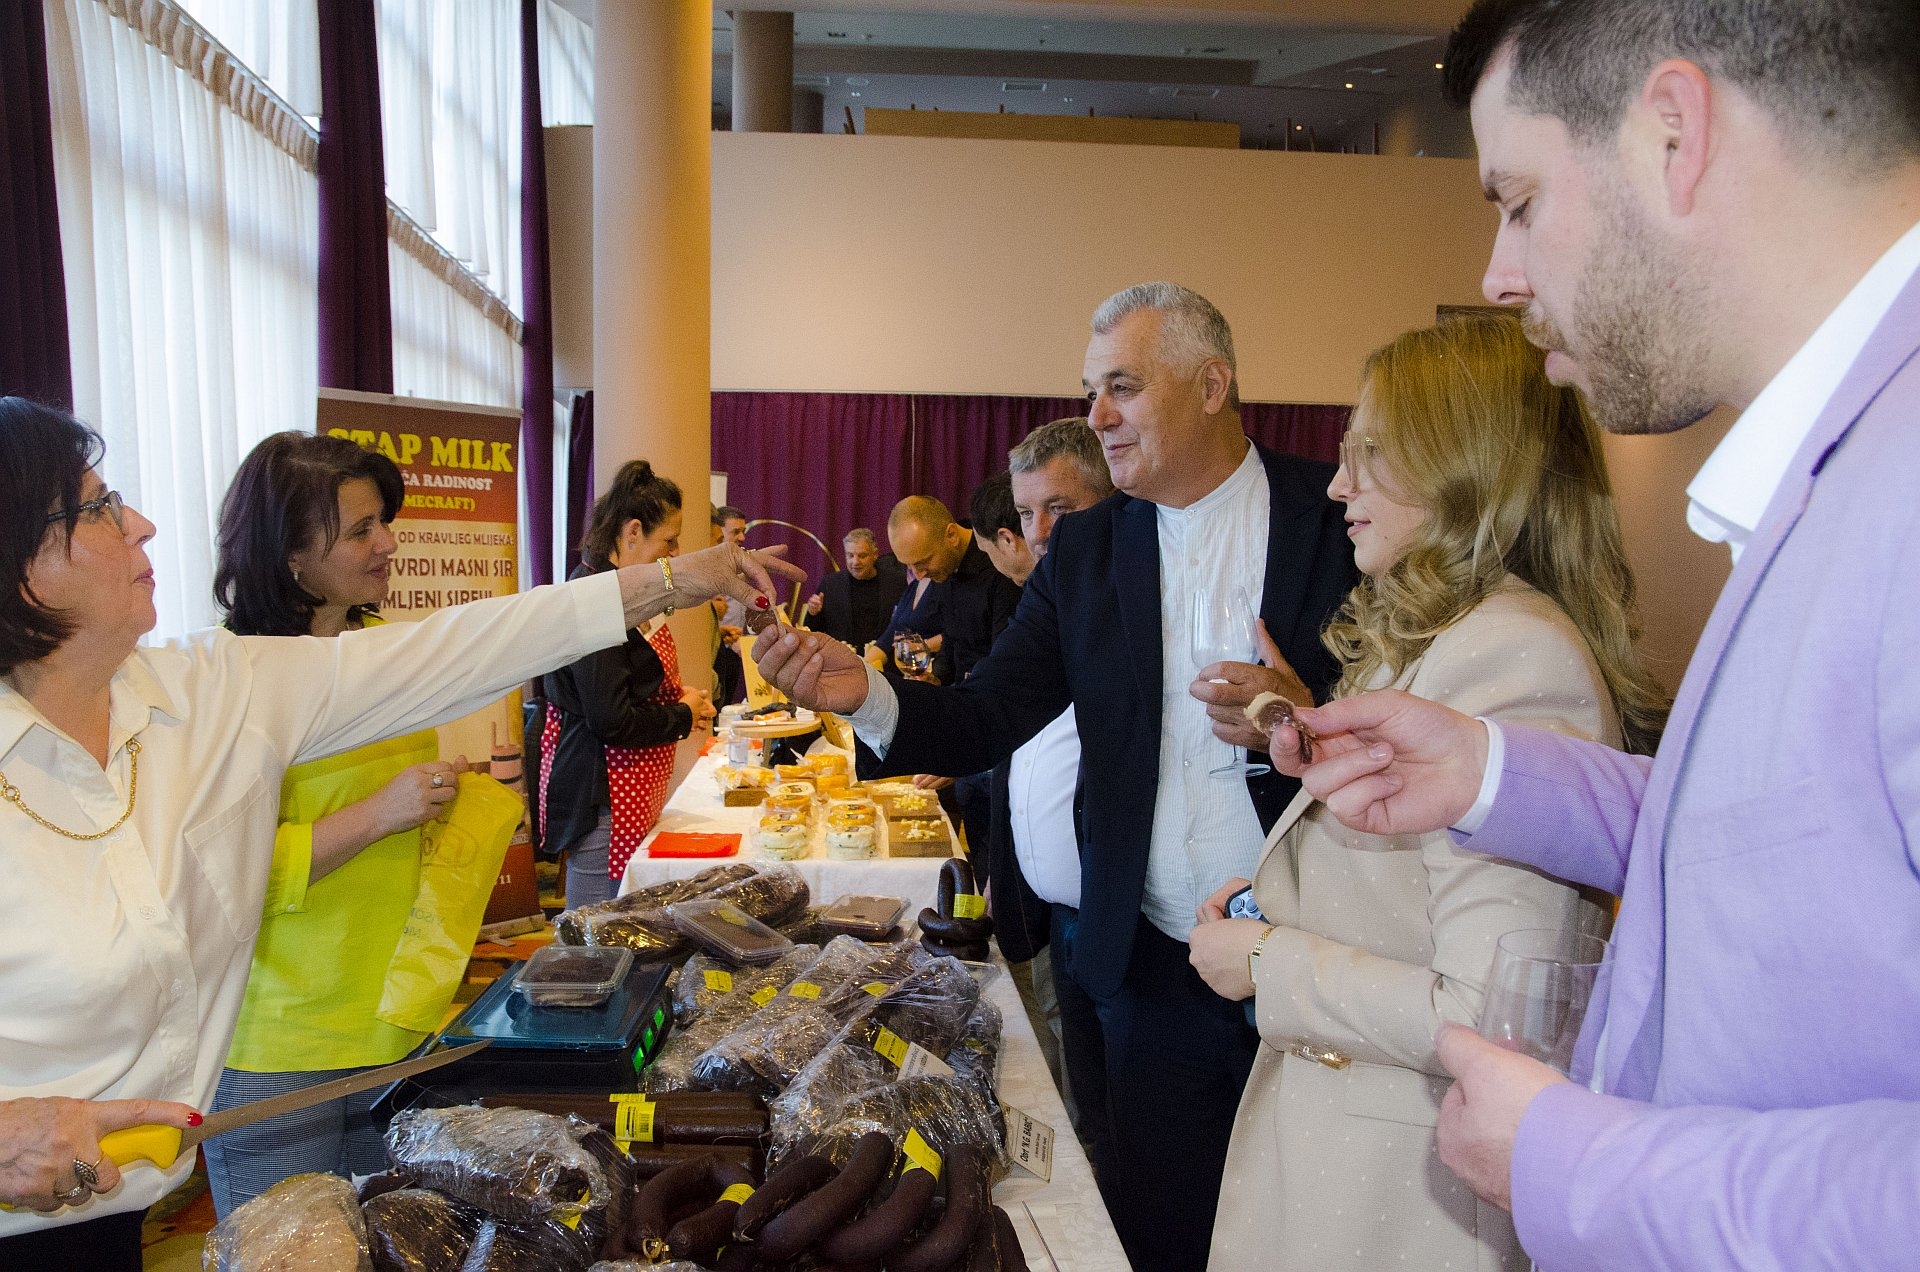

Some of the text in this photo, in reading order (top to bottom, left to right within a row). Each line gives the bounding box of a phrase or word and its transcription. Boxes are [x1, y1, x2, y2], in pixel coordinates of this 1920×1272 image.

[430, 436, 514, 473] MILK
[423, 474, 492, 491] RADINOST
[404, 494, 476, 512] MECRAFT)
[398, 531, 416, 544] OD
[418, 531, 472, 545] KRAVLJEG
[441, 558, 488, 577] MASNI
[493, 559, 513, 577] SIR
[383, 589, 442, 610] MLJENI
